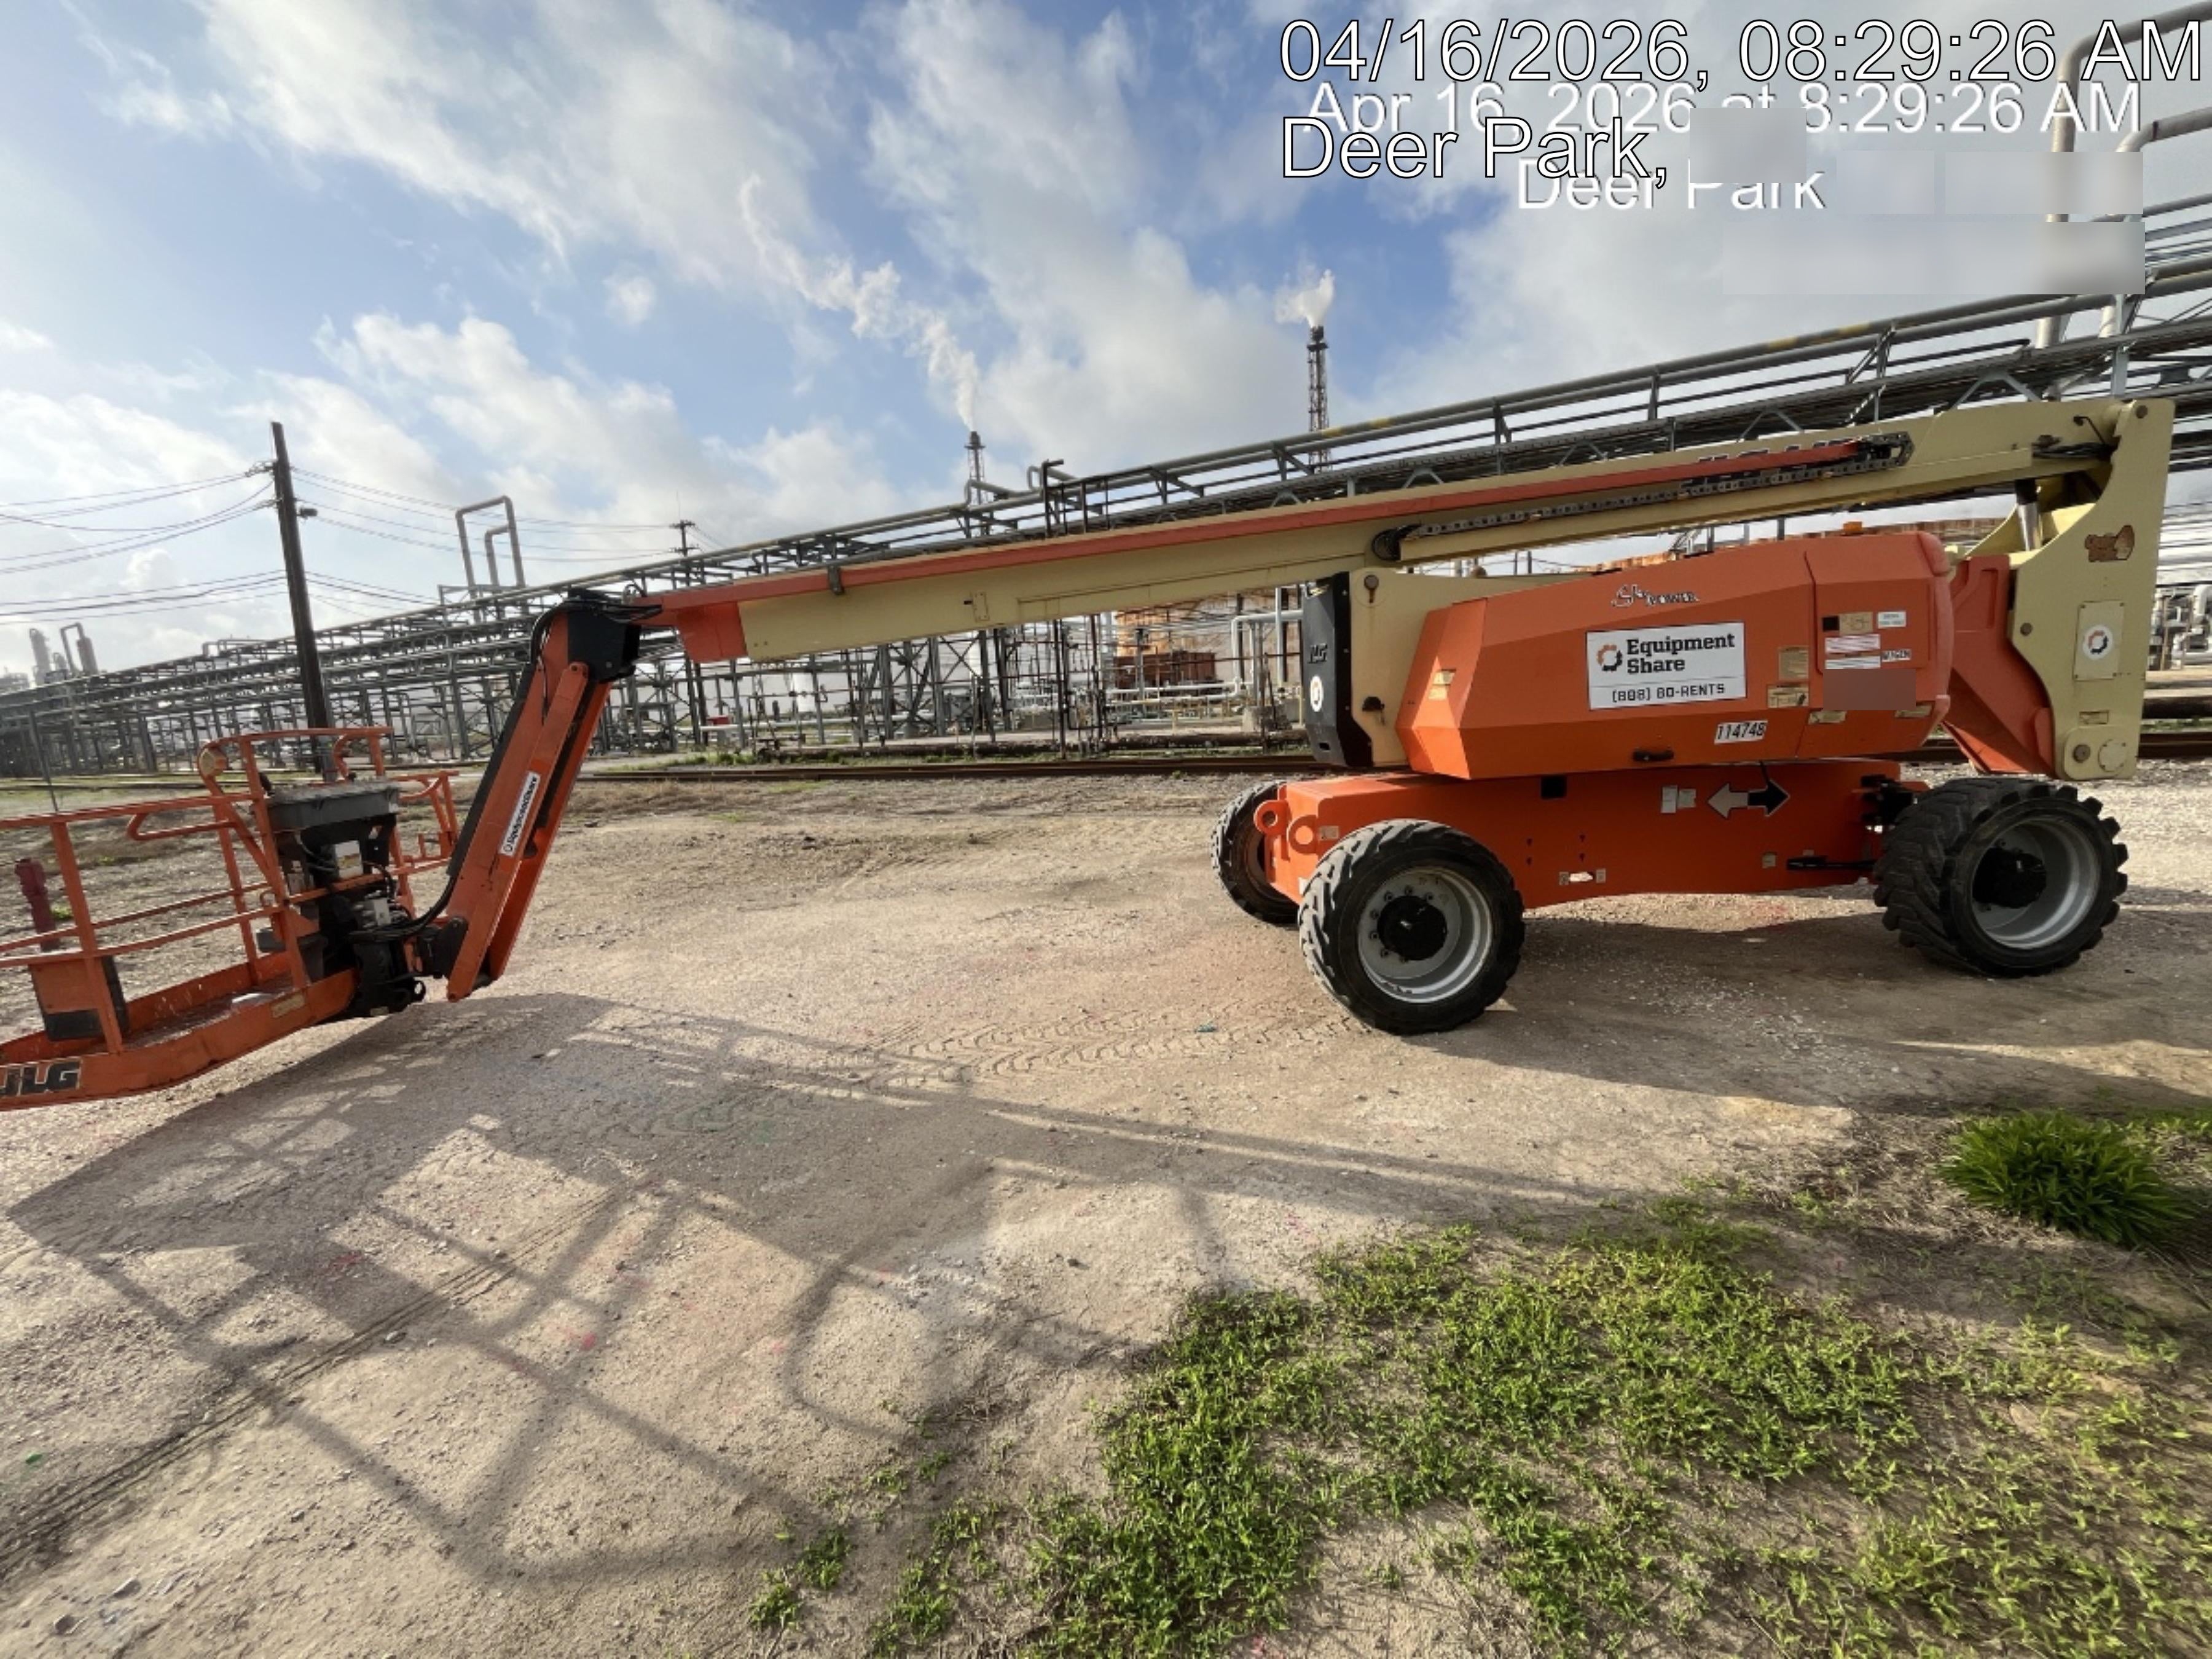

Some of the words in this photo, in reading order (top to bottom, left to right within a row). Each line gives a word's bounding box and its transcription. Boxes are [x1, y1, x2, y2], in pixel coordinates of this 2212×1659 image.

[1626, 633, 1736, 657] Equipment
[1627, 657, 1685, 674] Share
[1717, 722, 1766, 740] 114748
[0, 1056, 83, 1097] JLG
